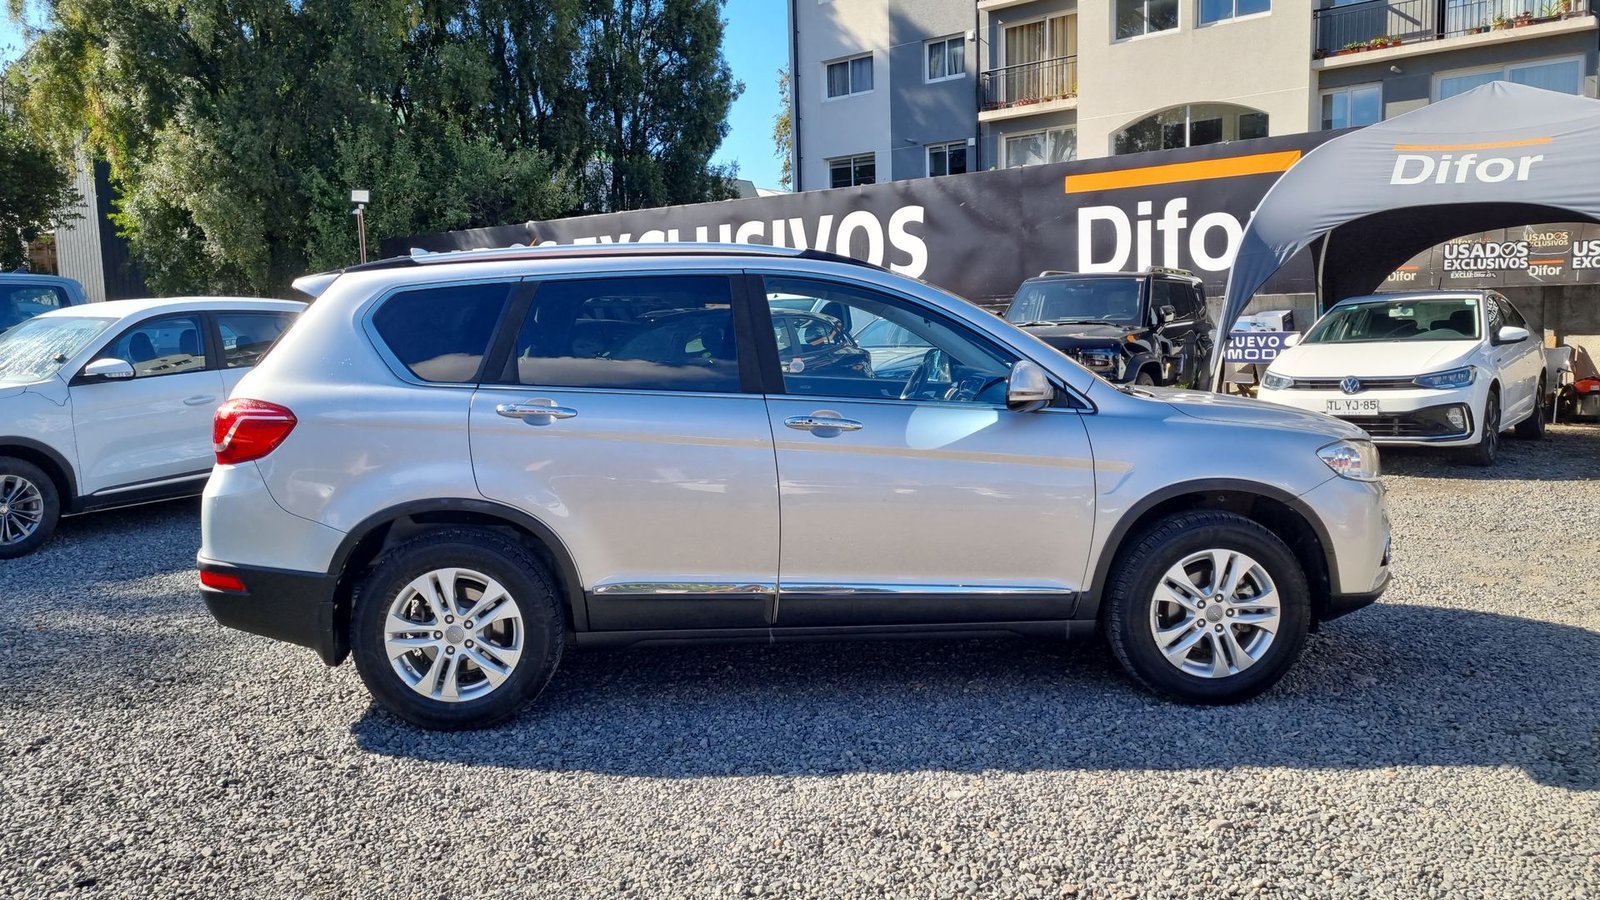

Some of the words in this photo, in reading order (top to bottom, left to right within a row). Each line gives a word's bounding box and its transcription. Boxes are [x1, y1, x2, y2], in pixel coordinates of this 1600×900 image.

[1390, 153, 1544, 185] Difor
[1078, 197, 1257, 274] Difo
[1444, 241, 1529, 259] USADOS
[1443, 257, 1528, 270] EXCLUSIVOS
[1529, 264, 1562, 276] Difor
